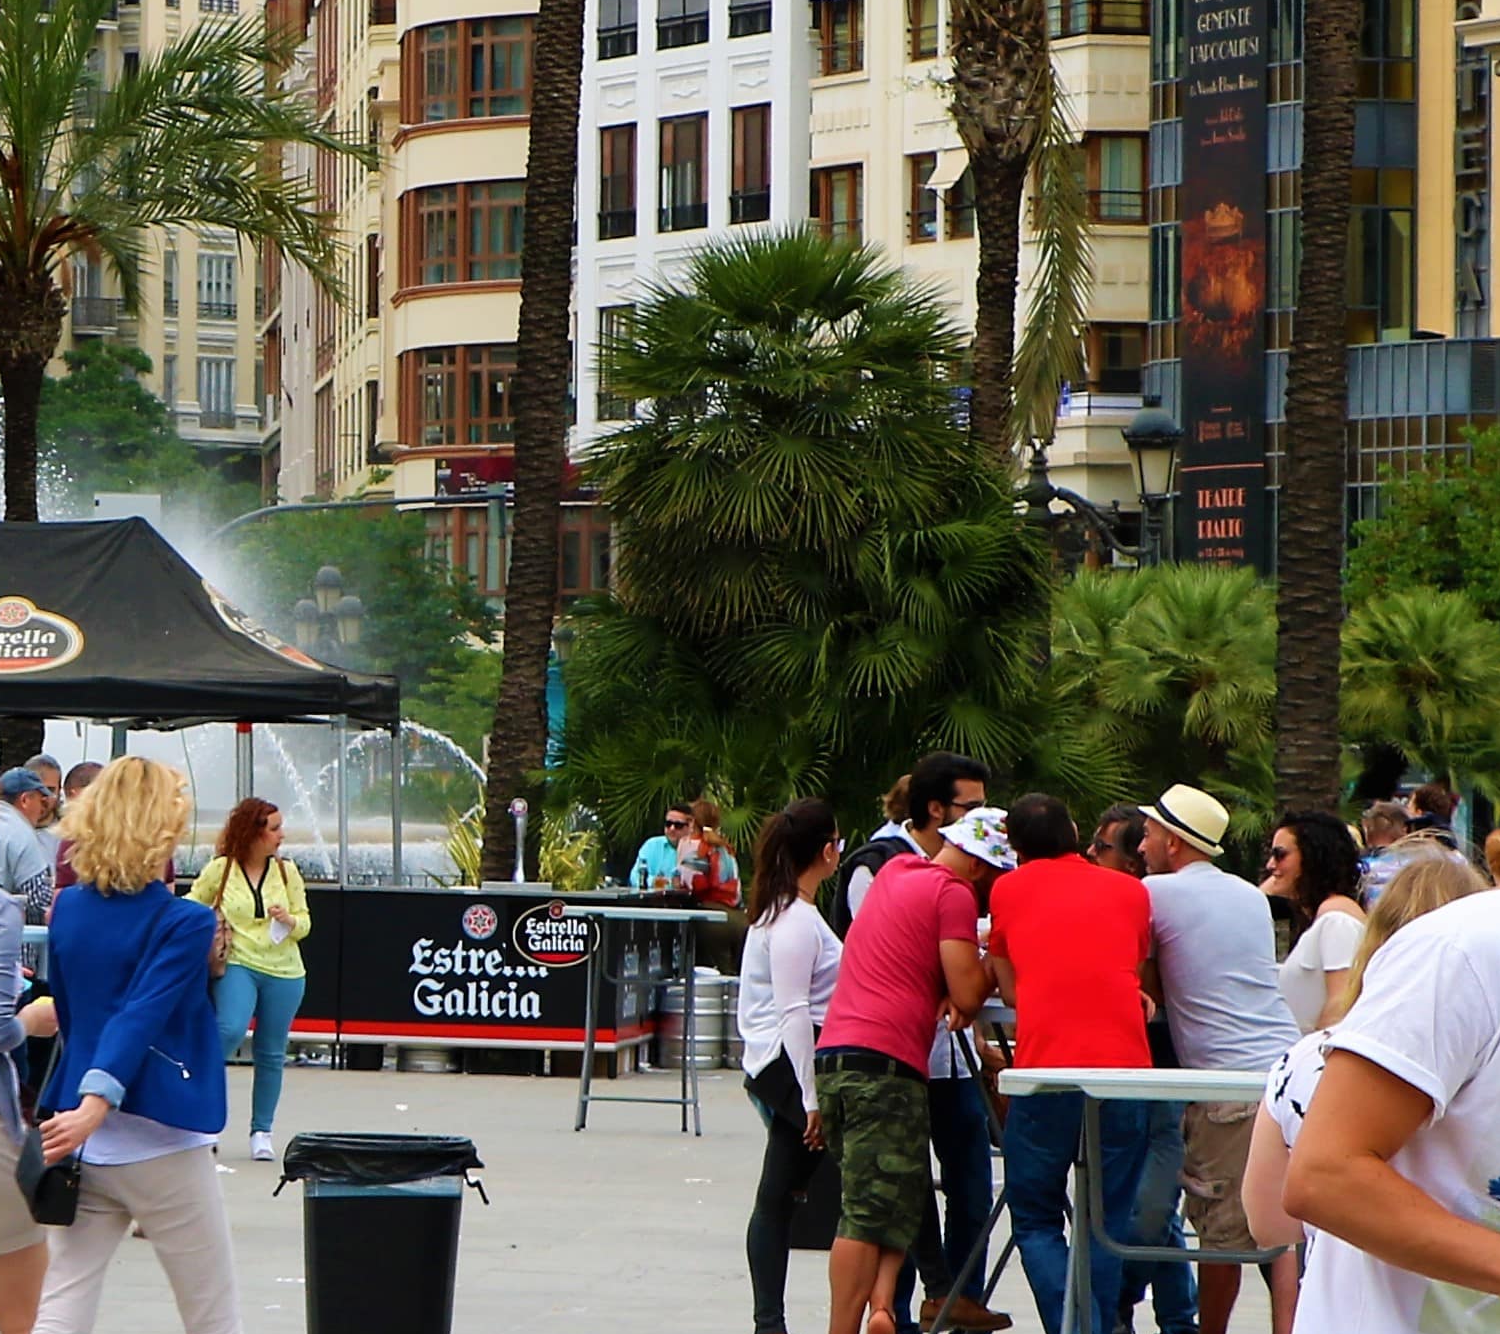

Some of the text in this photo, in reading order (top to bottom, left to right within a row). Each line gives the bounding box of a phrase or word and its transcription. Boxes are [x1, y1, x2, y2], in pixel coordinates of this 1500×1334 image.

[1197, 487, 1247, 509] TEATRE
[524, 917, 589, 936] Estrella
[527, 935, 586, 953] Galicia
[408, 937, 550, 979] Estre
[412, 977, 544, 1020] Galicia
